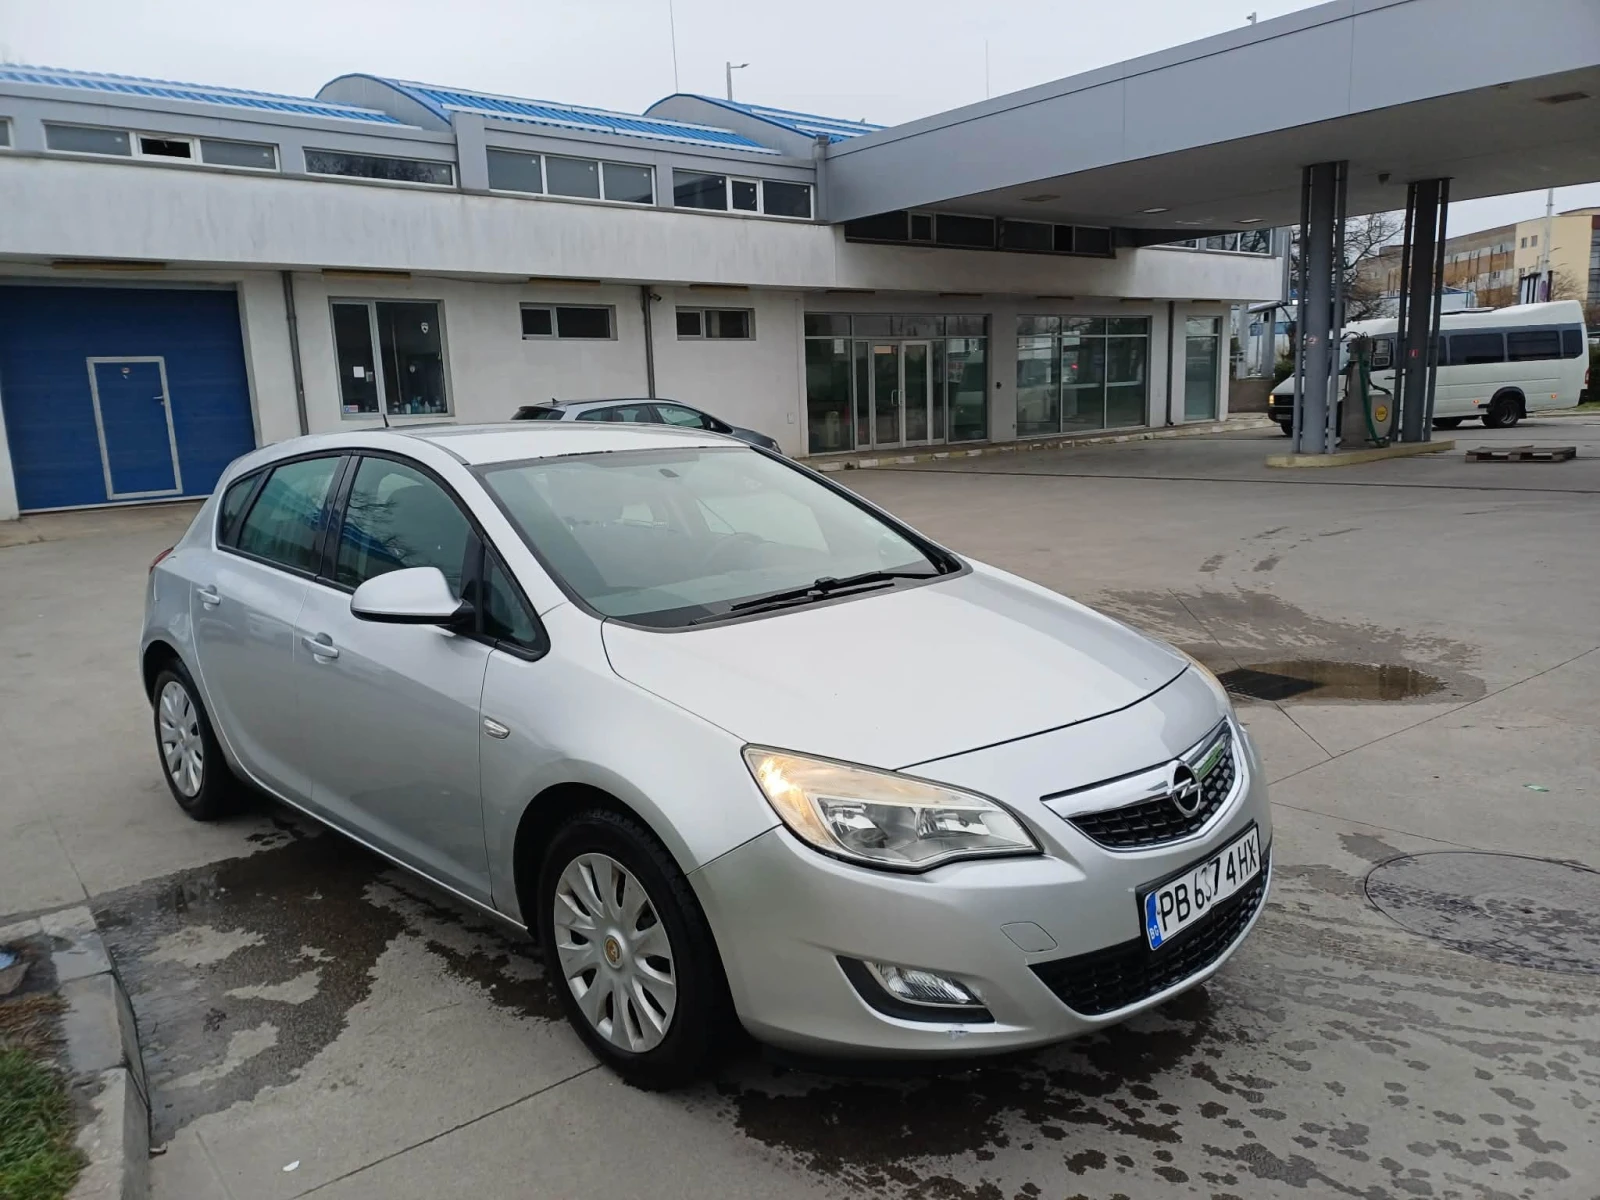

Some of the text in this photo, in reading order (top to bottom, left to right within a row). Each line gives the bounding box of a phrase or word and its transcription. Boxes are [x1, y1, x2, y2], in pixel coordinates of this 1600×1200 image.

[1160, 883, 1191, 932] PB
[1237, 835, 1257, 880] HX
[1149, 925, 1159, 939] BG
